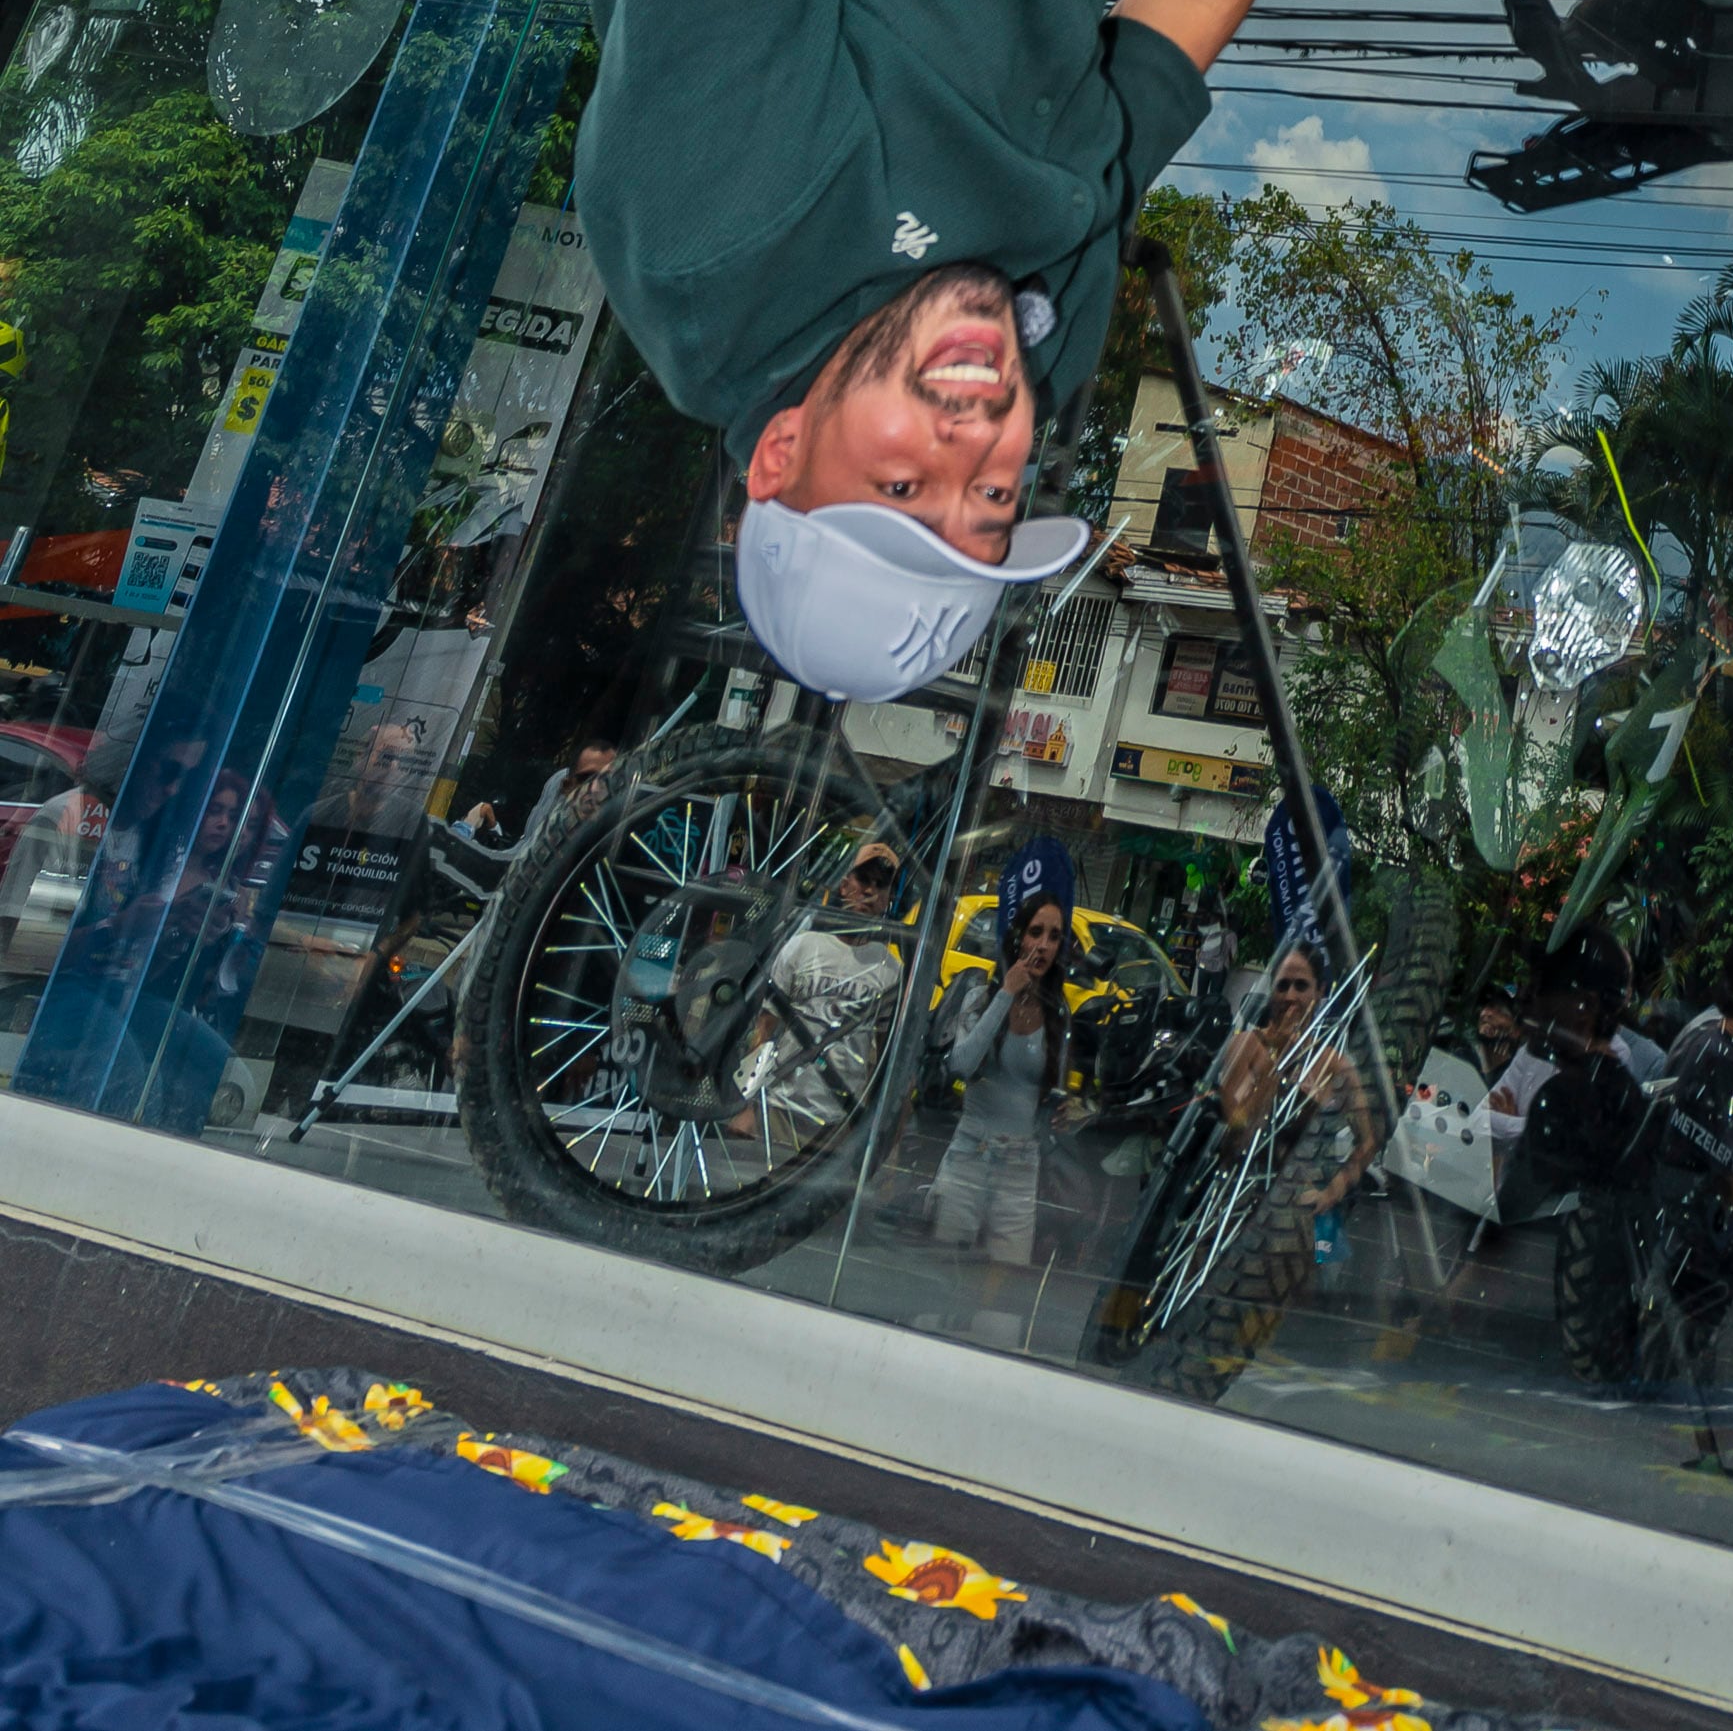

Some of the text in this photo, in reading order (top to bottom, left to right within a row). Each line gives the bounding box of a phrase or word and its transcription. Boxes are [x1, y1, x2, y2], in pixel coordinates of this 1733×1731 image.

[541, 225, 588, 249] MOT
[256, 336, 289, 353] GAR
[250, 354, 281, 369] PAR
[248, 373, 273, 390] SÓL
[1671, 1108, 1732, 1167] METZELER
